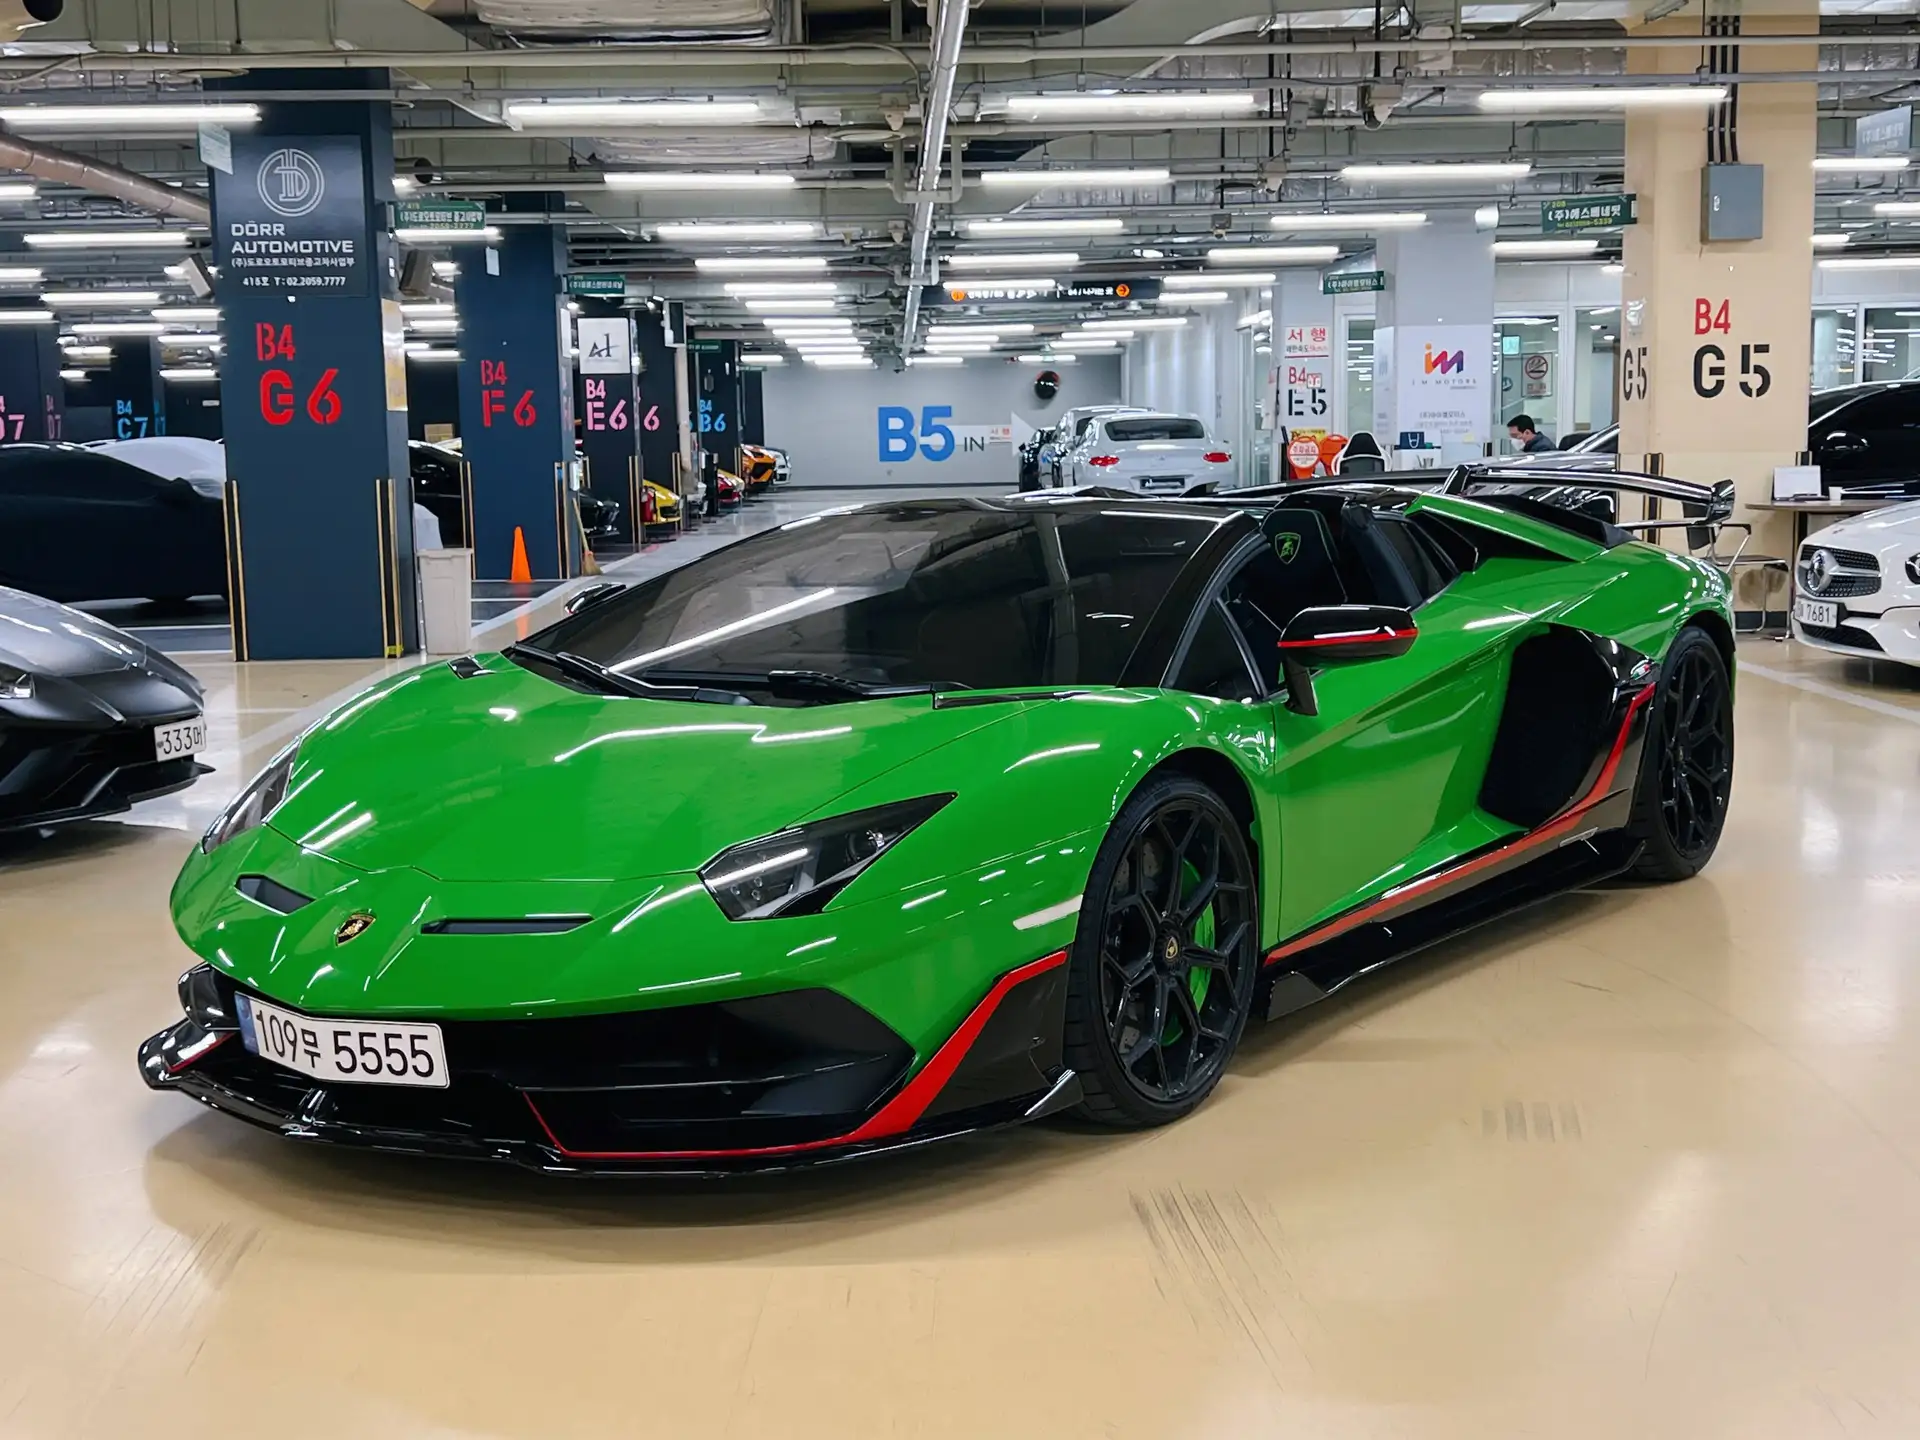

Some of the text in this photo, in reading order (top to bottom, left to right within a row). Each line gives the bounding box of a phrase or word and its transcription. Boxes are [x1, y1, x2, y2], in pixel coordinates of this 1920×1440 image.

[231, 220, 286, 236] DÖRR
[231, 240, 354, 254] AUTOMOTIVE
[1695, 298, 1731, 335] B4
[256, 322, 296, 361] B4
[481, 360, 507, 386] B4
[1288, 366, 1306, 384] B4
[1623, 347, 1647, 401] G5
[1693, 344, 1771, 398] G5
[260, 368, 342, 426] G6
[586, 379, 606, 399] B4
[1287, 389, 1327, 415] E5
[116, 400, 132, 415] B4
[482, 389, 536, 427] F6
[586, 399, 628, 431] E6
[117, 417, 148, 439] C7
[878, 405, 985, 462] B5 IN
[1807, 604, 1830, 624] 7681
[256, 1010, 434, 1078] 109무 5555
